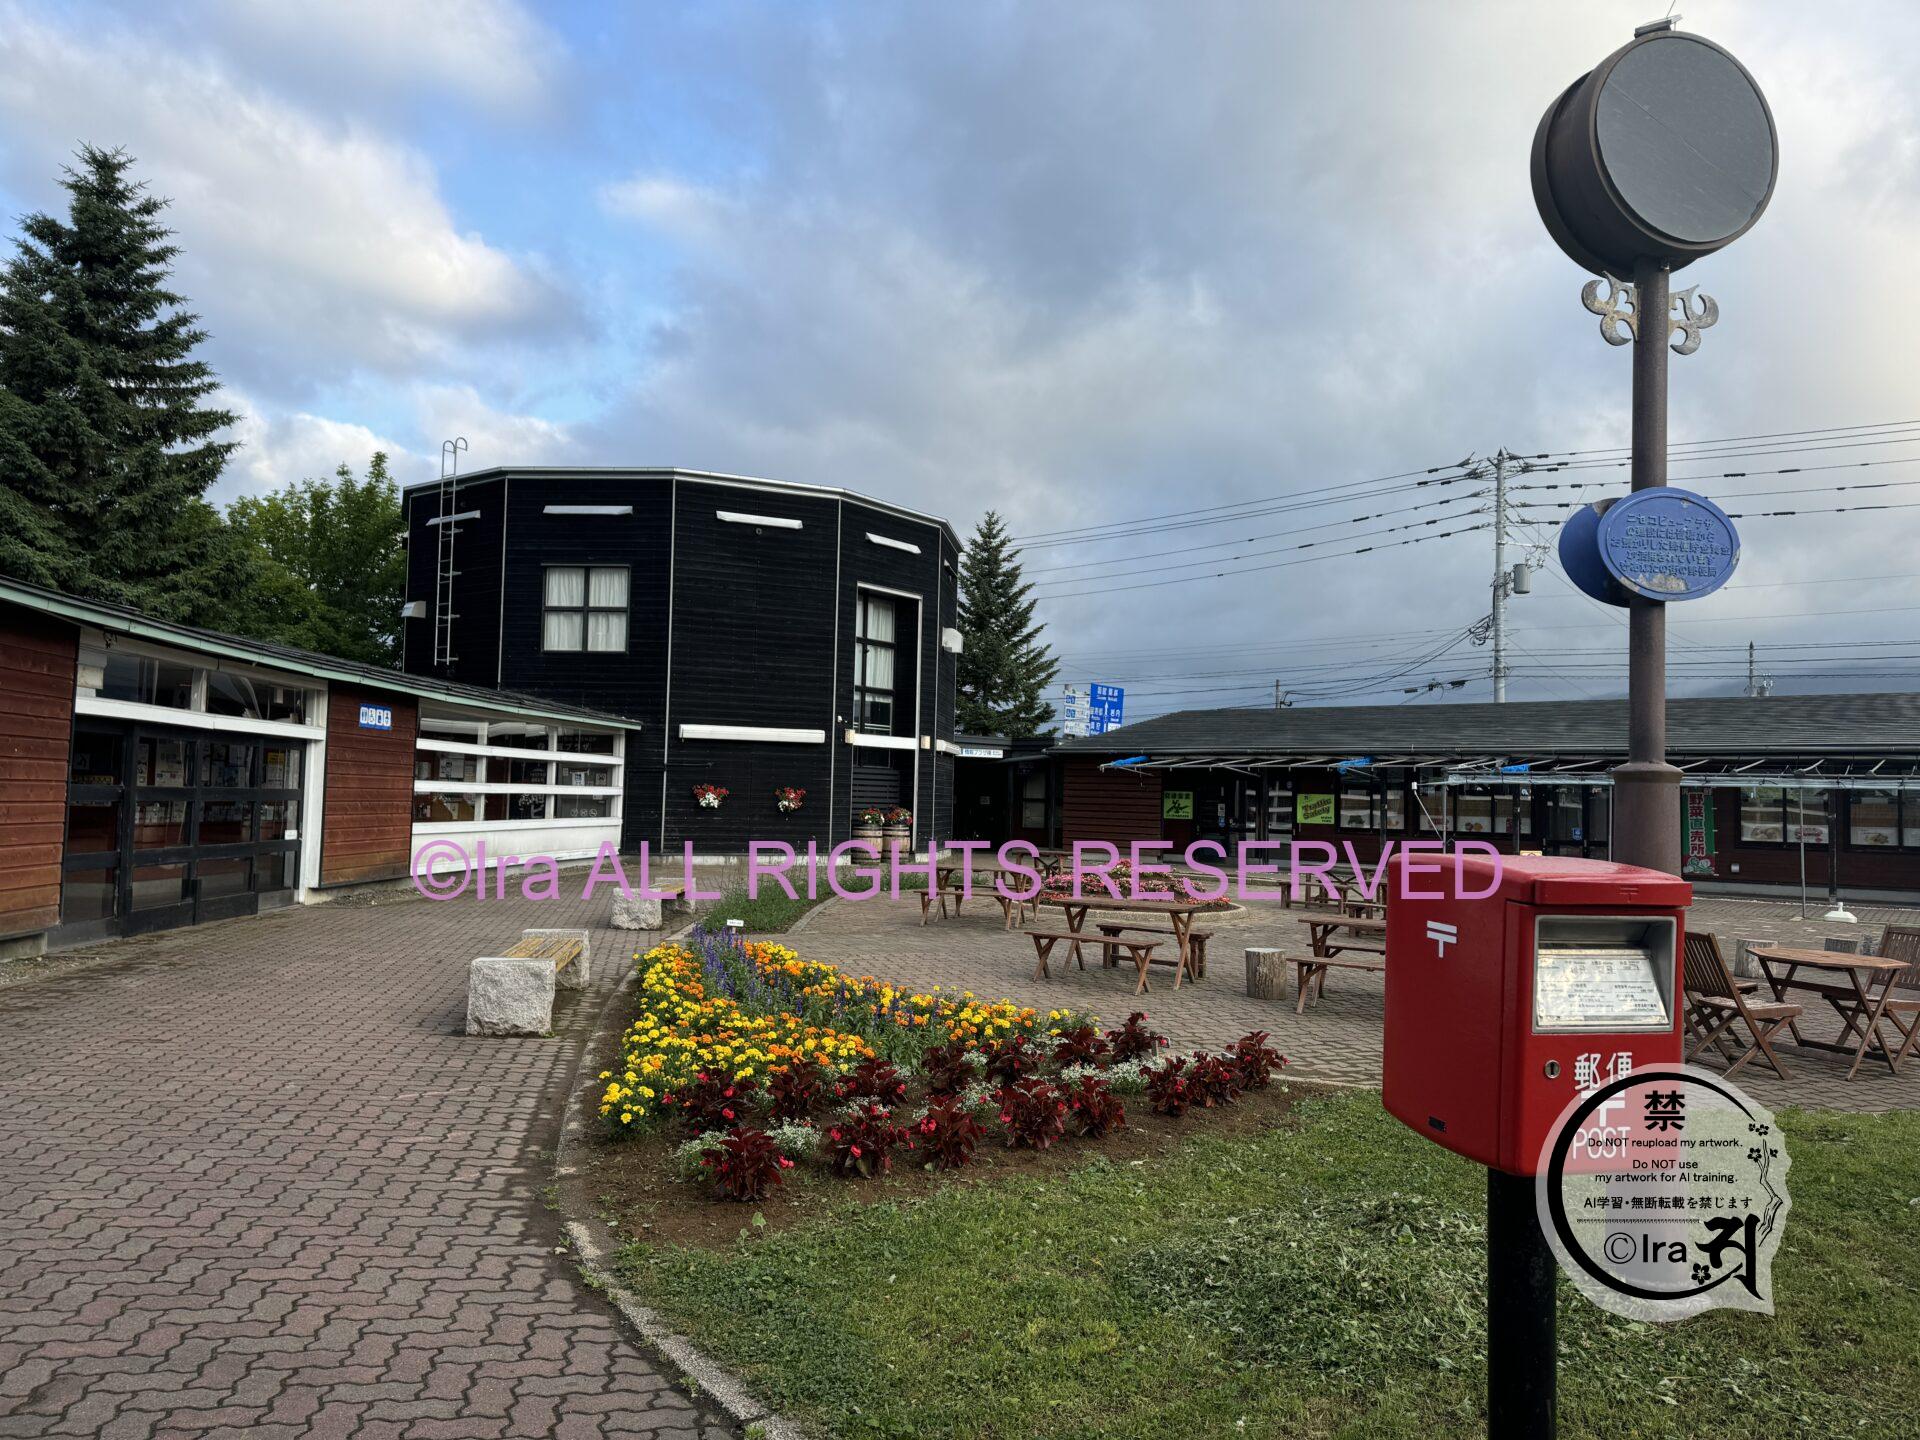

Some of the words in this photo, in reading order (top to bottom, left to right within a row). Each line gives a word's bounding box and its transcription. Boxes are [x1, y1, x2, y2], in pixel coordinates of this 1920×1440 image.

[1626, 513, 1714, 530] ニセコビュープラザ
[1689, 793, 1705, 857] 野菜直売所
[1574, 1051, 1633, 1090] 郵便
[1572, 1126, 1631, 1159] POST
